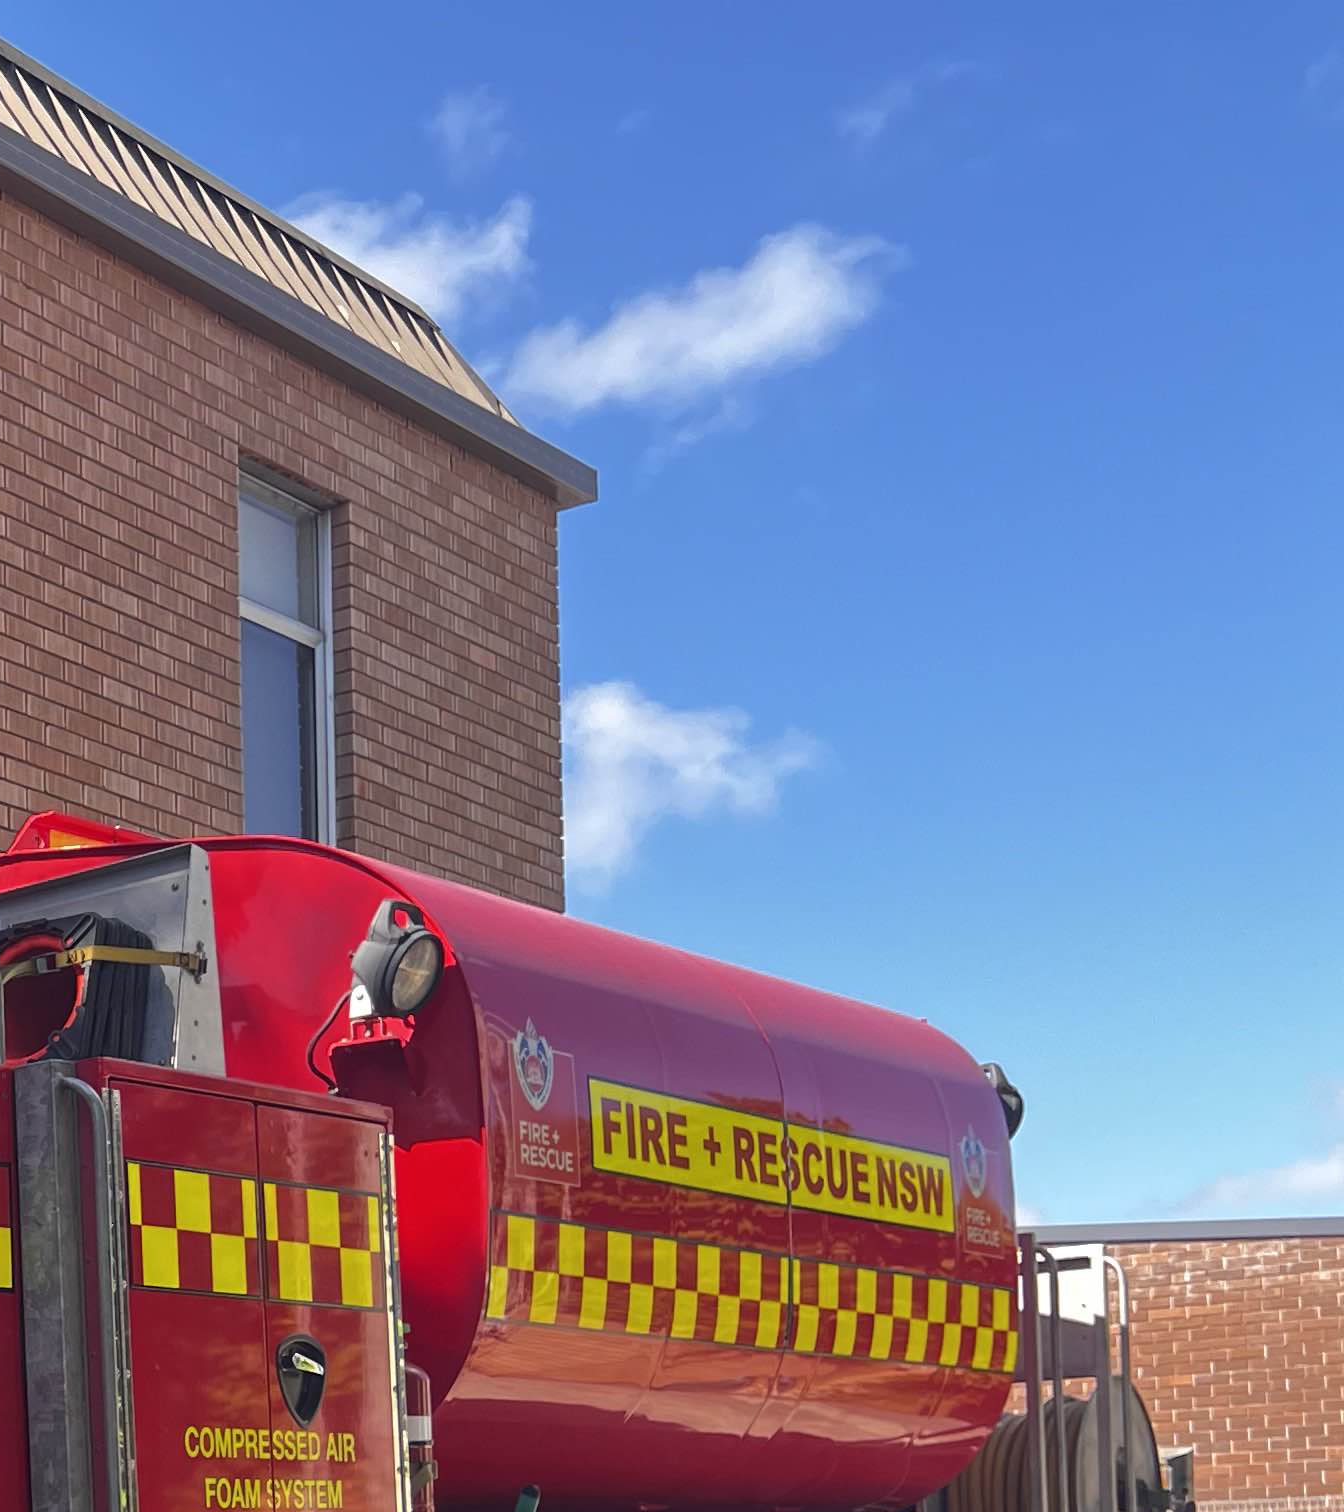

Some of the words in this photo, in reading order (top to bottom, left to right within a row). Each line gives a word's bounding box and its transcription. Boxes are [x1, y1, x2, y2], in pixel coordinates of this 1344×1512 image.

[520, 1144, 574, 1173] RESCUE
[599, 1097, 690, 1170] FIRE
[732, 1126, 871, 1203] RESCUE
[876, 1156, 944, 1217] NSW
[966, 1226, 1001, 1248] RESCUE
[184, 1426, 321, 1461] COMPRESSED
[326, 1432, 357, 1463] AIR
[204, 1476, 261, 1509] FOAM
[266, 1479, 343, 1510] SYSTEM
